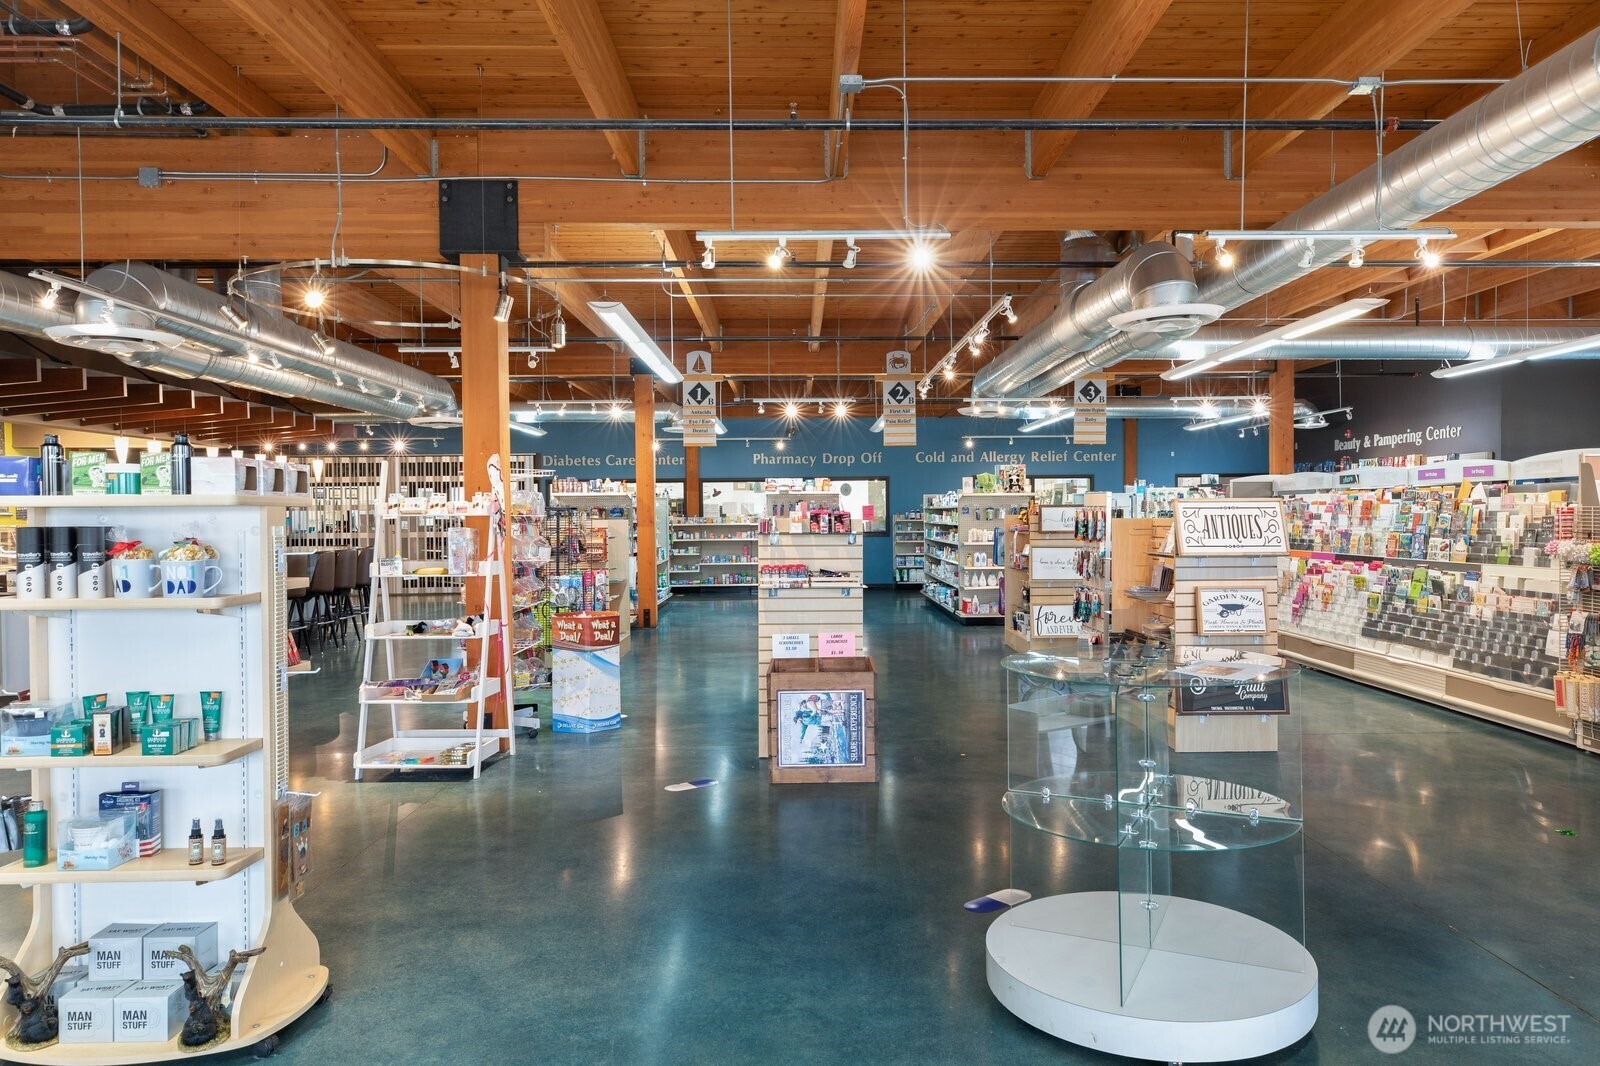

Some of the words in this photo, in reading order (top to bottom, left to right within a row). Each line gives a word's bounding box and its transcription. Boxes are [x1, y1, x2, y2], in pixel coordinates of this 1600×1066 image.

[695, 387, 702, 401] 1
[895, 386, 905, 400] 2
[1086, 386, 1095, 400] 3
[1334, 439, 1361, 452] Beauty
[1364, 435, 1371, 448] &
[1374, 429, 1422, 448] Pampering
[1426, 425, 1461, 441] Center
[73, 456, 88, 468] FOR
[88, 453, 105, 464] MEN
[141, 456, 155, 468] FOR
[155, 453, 170, 464] MEN
[543, 454, 600, 466] Diabetes
[605, 454, 636, 466] Care
[654, 455, 685, 465] enter
[753, 453, 817, 467] Pharmacy
[822, 453, 855, 466] Drop
[861, 452, 882, 464] Off
[915, 451, 945, 463] Cold
[951, 451, 974, 463] and
[980, 452, 1025, 465] Allergy
[1031, 450, 1068, 462] Relief
[1073, 450, 1116, 462] Center
[1202, 514, 1263, 543] ANTIQUES
[115, 580, 131, 593] AD
[167, 580, 196, 594] DAD
[1203, 594, 1237, 606] GARDEN
[1240, 595, 1263, 606] SHED
[557, 620, 576, 630] What
[591, 620, 609, 630] What
[1046, 625, 1058, 633] AND
[560, 631, 581, 643] Deal!
[594, 630, 614, 642] Deal!
[1240, 690, 1268, 701] Company
[850, 694, 858, 730] EXPERIENCE
[850, 741, 858, 761] SHARE
[97, 951, 121, 961] MAN
[96, 961, 121, 969] STUFF
[67, 1012, 92, 1021] MAN
[122, 1011, 147, 1020] MAN
